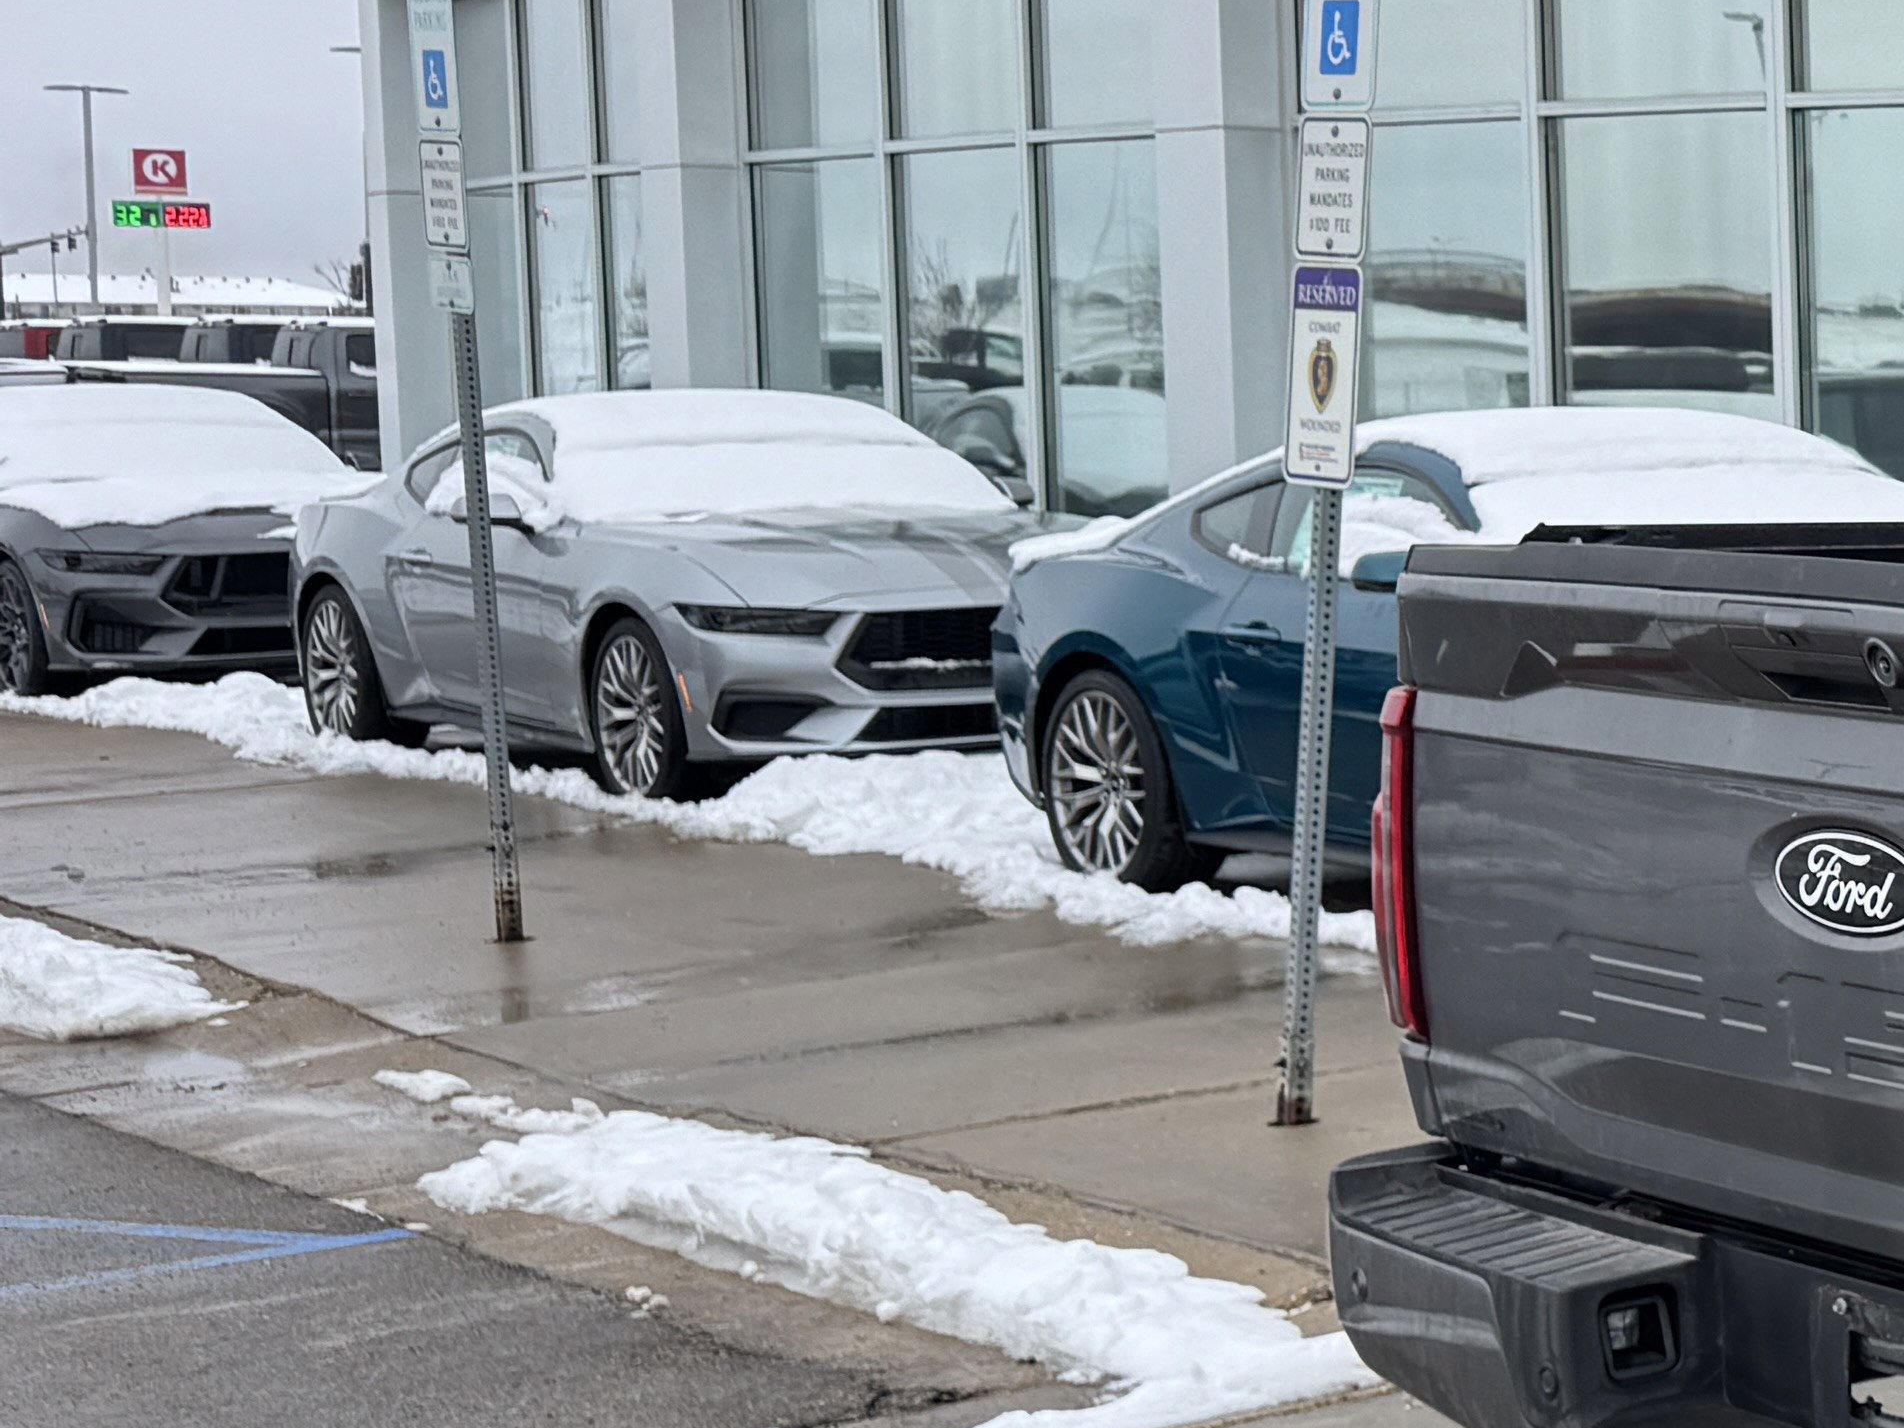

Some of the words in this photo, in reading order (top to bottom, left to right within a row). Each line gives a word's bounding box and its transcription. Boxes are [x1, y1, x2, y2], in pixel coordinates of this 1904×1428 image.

[151, 159, 176, 182] K
[1314, 167, 1351, 183] PARKING
[1334, 217, 1351, 234] FEE
[1297, 283, 1357, 306] RESERVED
[1798, 844, 1897, 921] Ford
